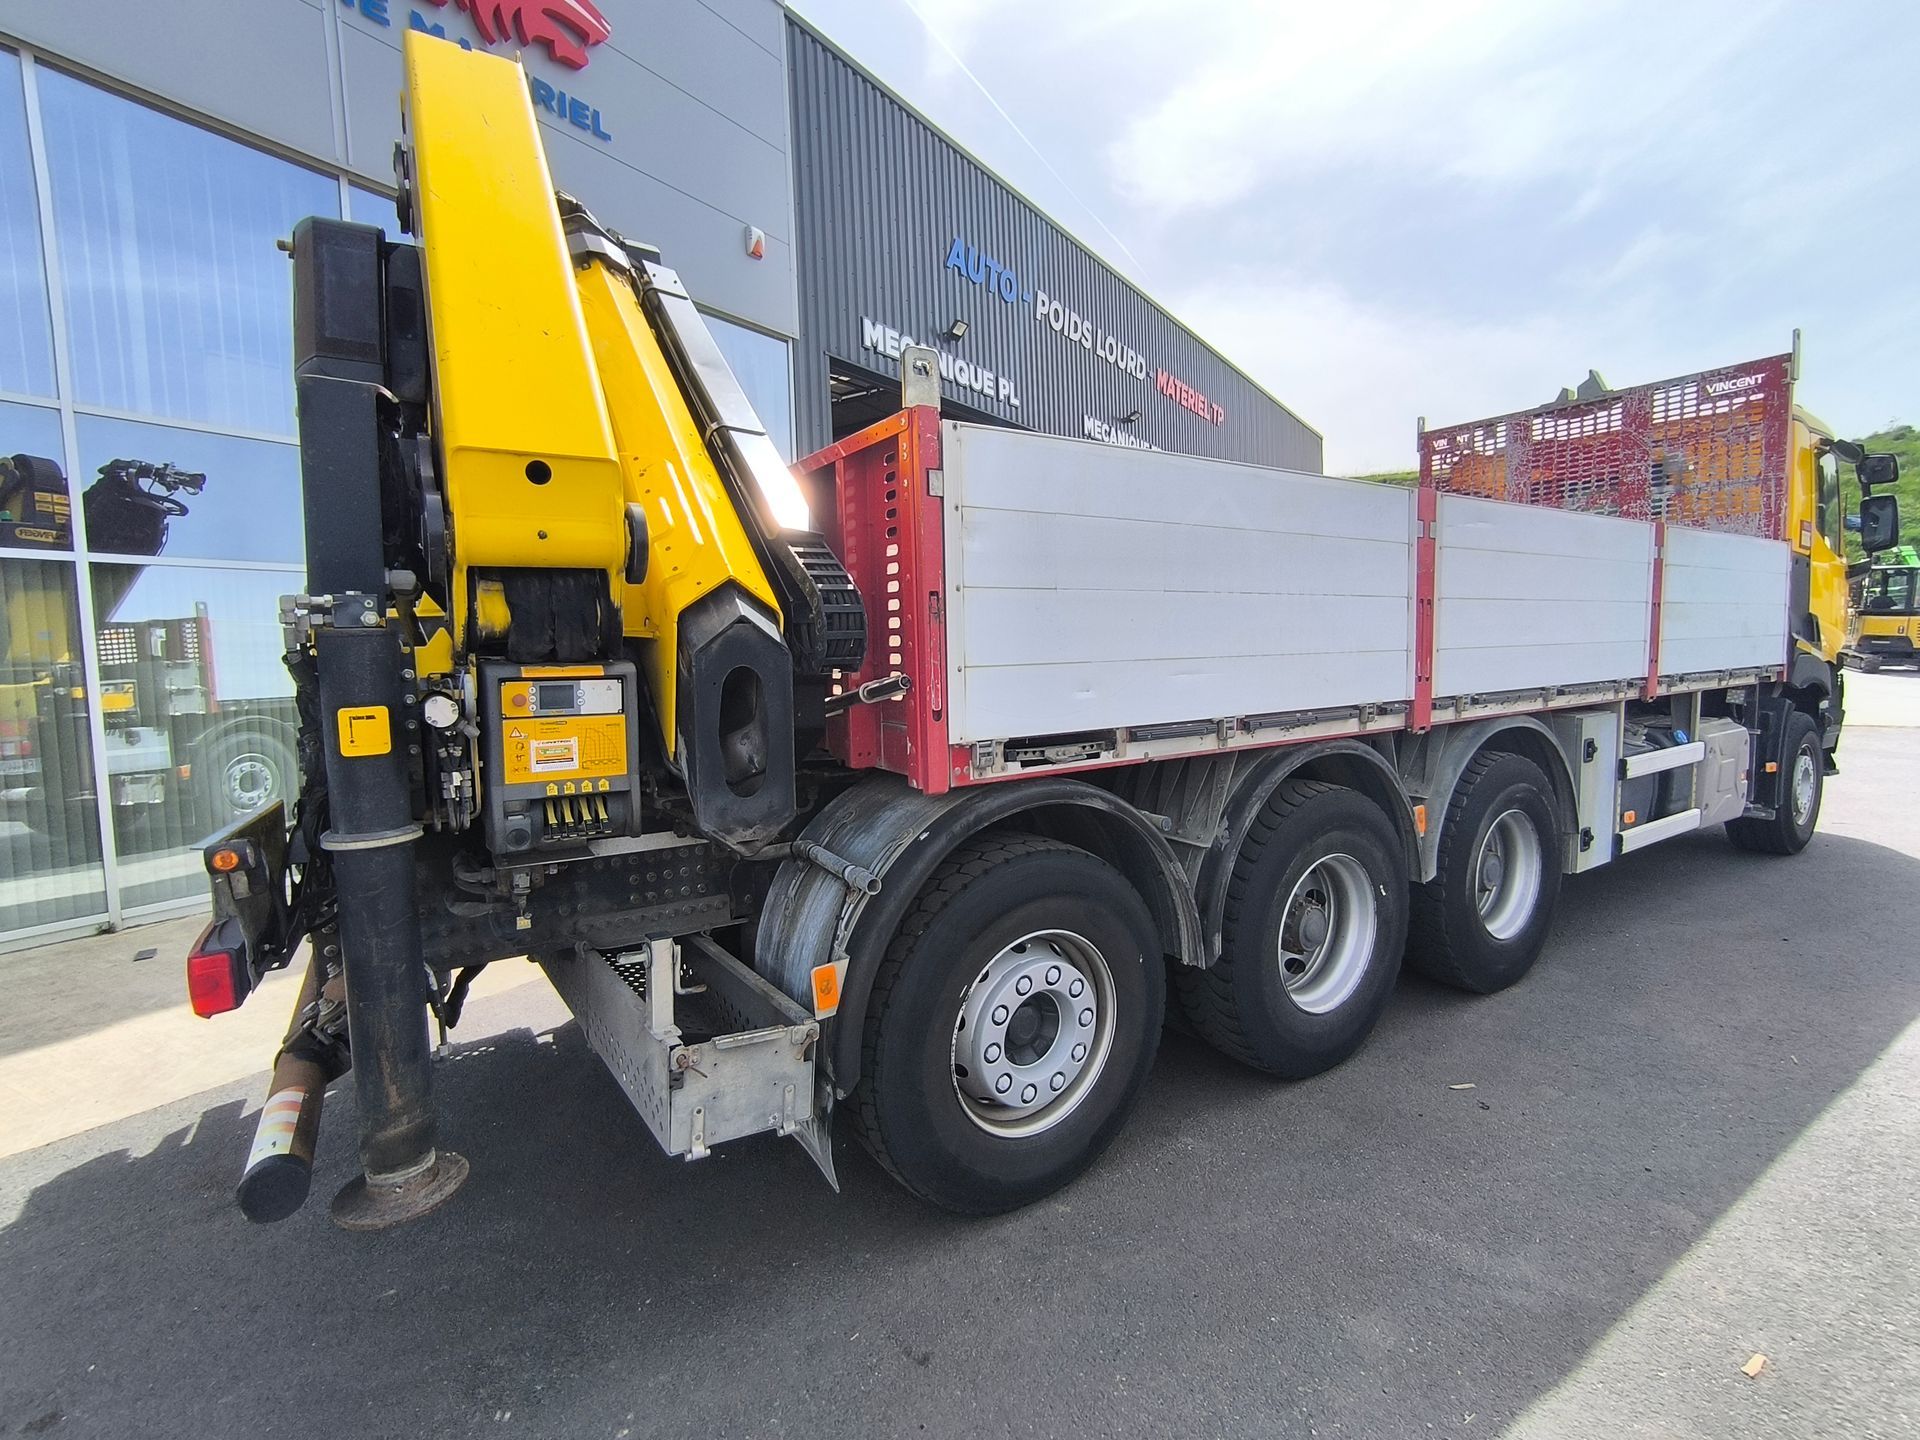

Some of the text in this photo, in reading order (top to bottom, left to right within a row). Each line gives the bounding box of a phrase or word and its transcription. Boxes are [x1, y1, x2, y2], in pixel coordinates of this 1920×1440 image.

[946, 237, 1018, 303] AUTO
[1036, 290, 1092, 349] POIDS
[1095, 328, 1146, 380] LOURD
[1157, 368, 1211, 420] MATERIEL
[1211, 402, 1225, 427] TP
[861, 316, 1020, 408] MECNIQUE PL
[1706, 374, 1765, 394] VINCENT
[1433, 434, 1470, 448] VINNT
